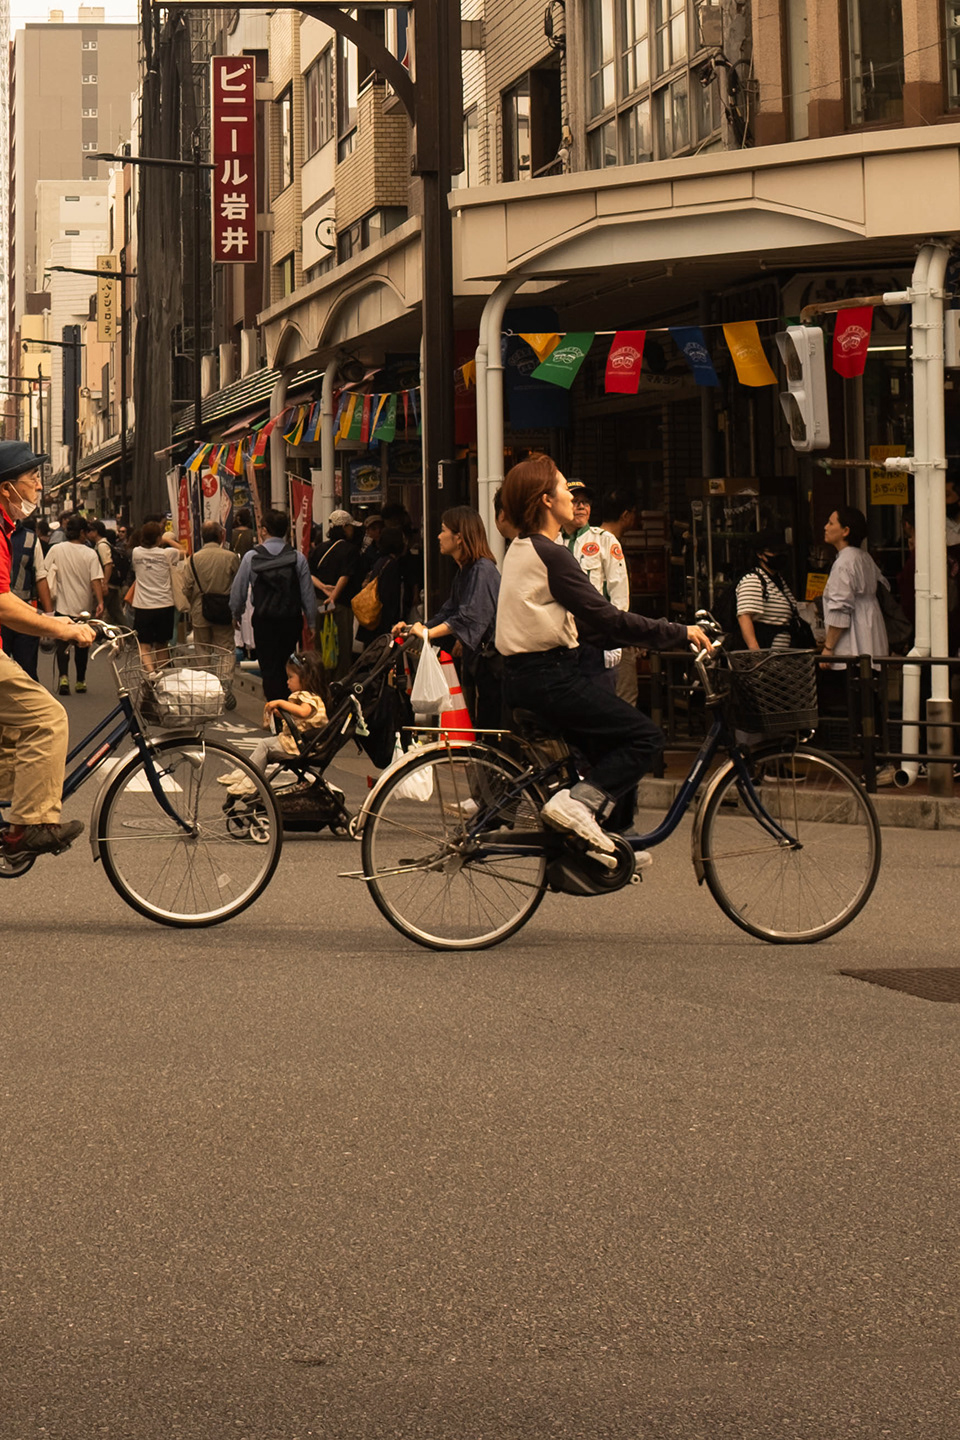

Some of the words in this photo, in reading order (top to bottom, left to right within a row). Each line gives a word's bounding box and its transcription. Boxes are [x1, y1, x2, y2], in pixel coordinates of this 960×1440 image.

[221, 63, 250, 254] ビニール岩井
